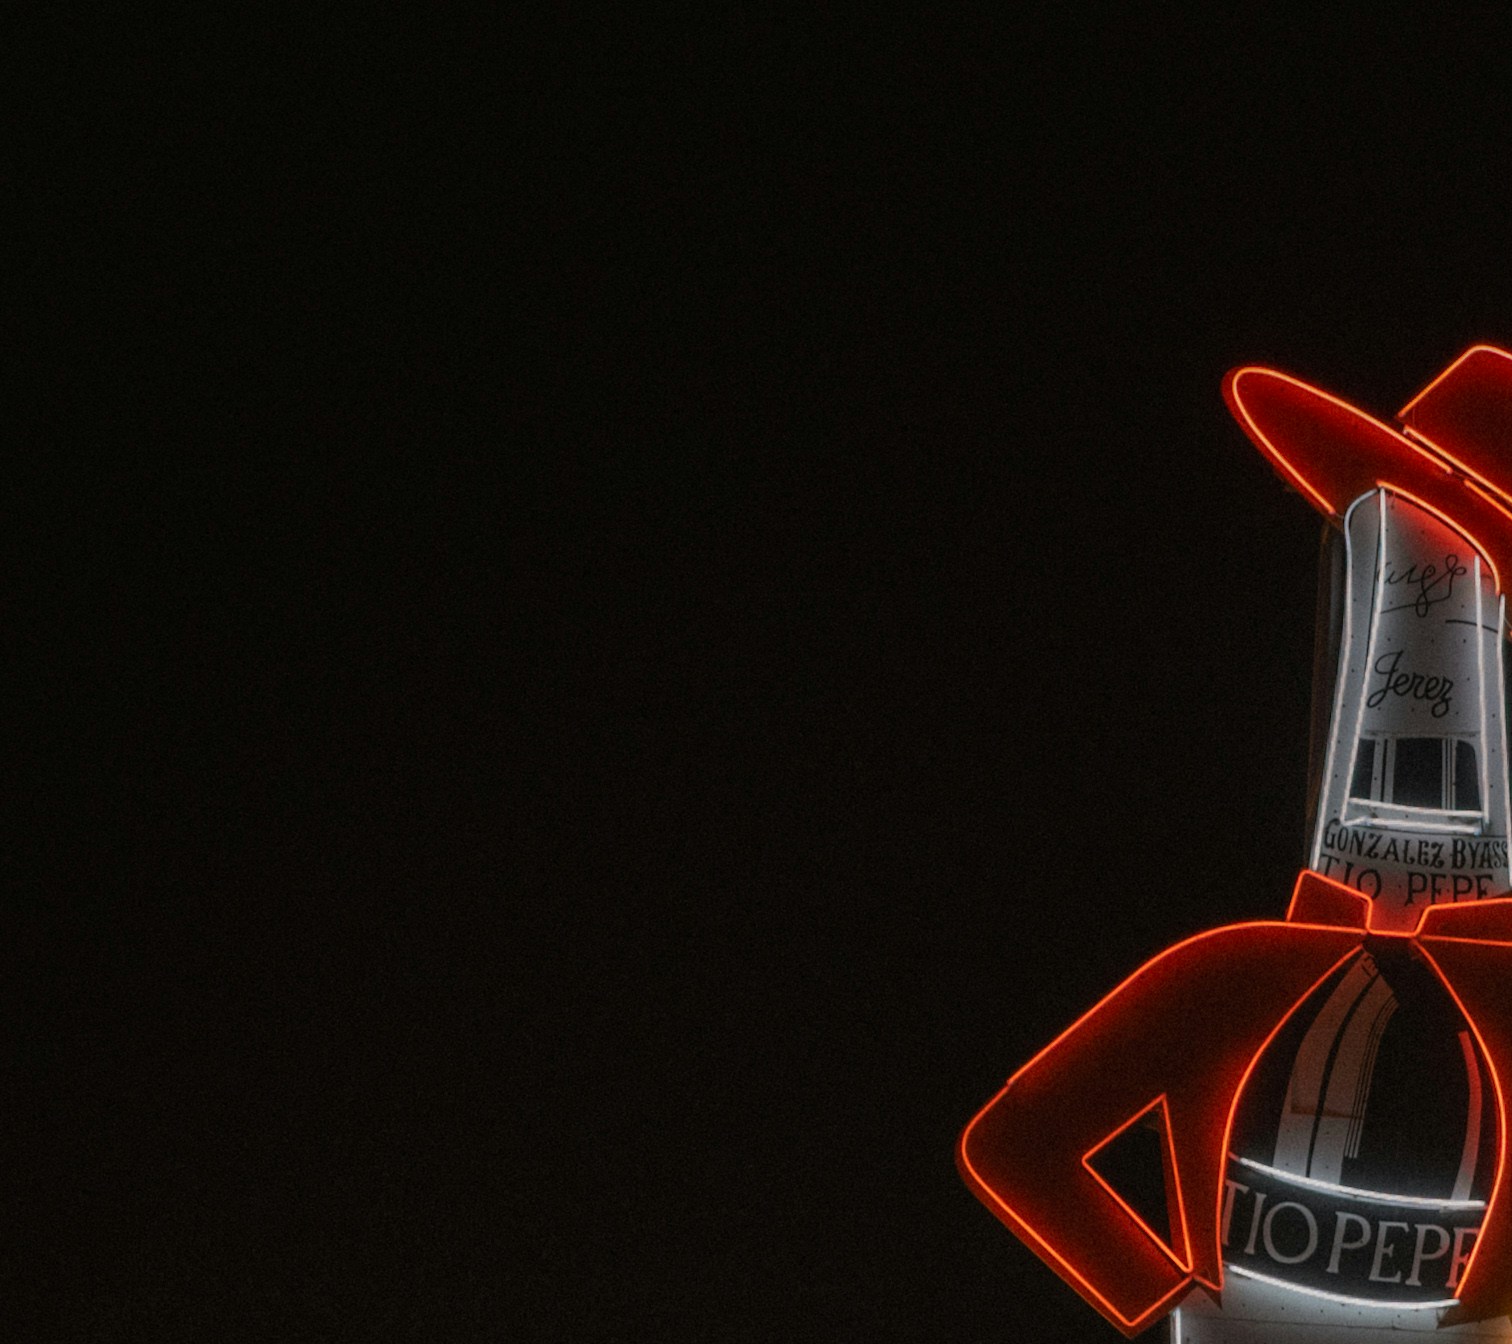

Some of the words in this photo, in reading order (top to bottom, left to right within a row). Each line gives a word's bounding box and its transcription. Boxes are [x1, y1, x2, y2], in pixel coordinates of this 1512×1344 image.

[1367, 651, 1453, 718] Jerez
[1324, 818, 1446, 868] GONZALEZ
[1451, 837, 1509, 869] BYASS
[1222, 1179, 1318, 1264] TIO
